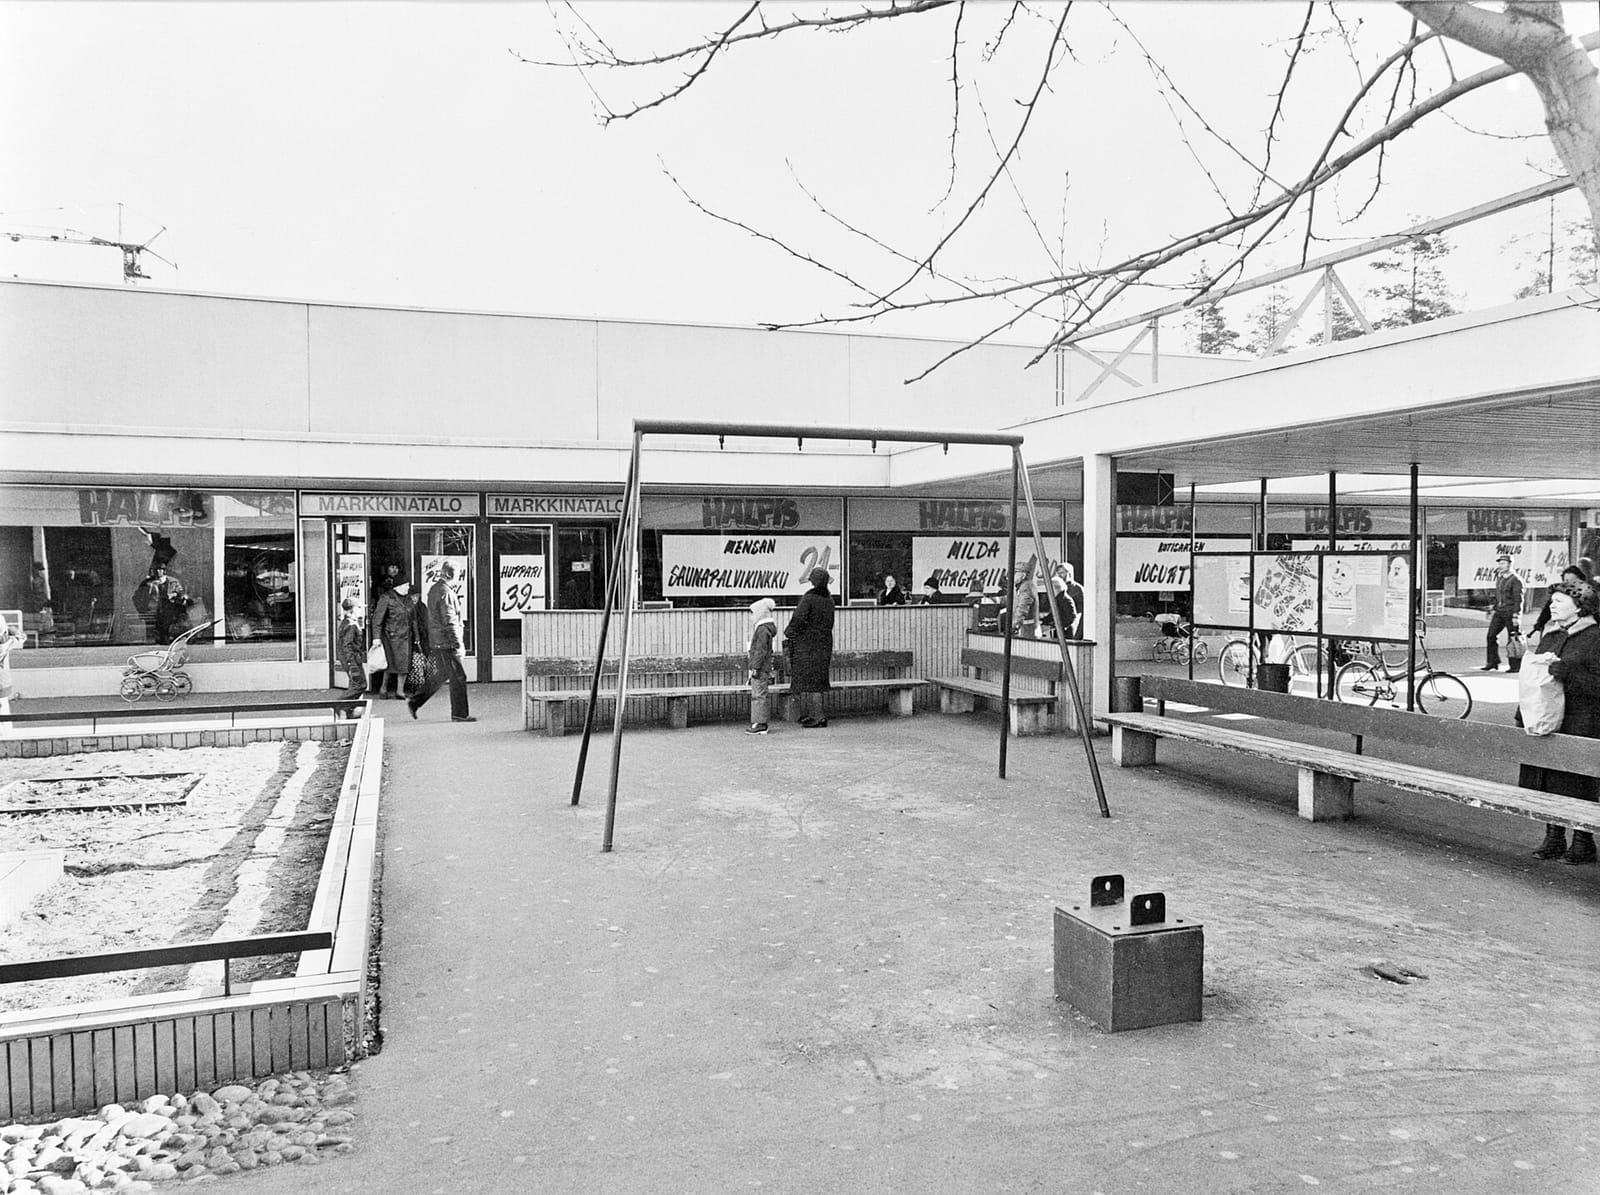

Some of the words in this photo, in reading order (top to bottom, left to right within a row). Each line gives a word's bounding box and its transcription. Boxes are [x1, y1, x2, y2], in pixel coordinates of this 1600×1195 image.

[318, 496, 462, 512] MARKKINATALO
[724, 539, 776, 555] MENSAN
[947, 541, 1000, 560] MILDA
[501, 565, 542, 578] HUPPARI
[668, 564, 789, 589] SAUNAPALVIKINKKU
[1134, 563, 1191, 585] JOGURT
